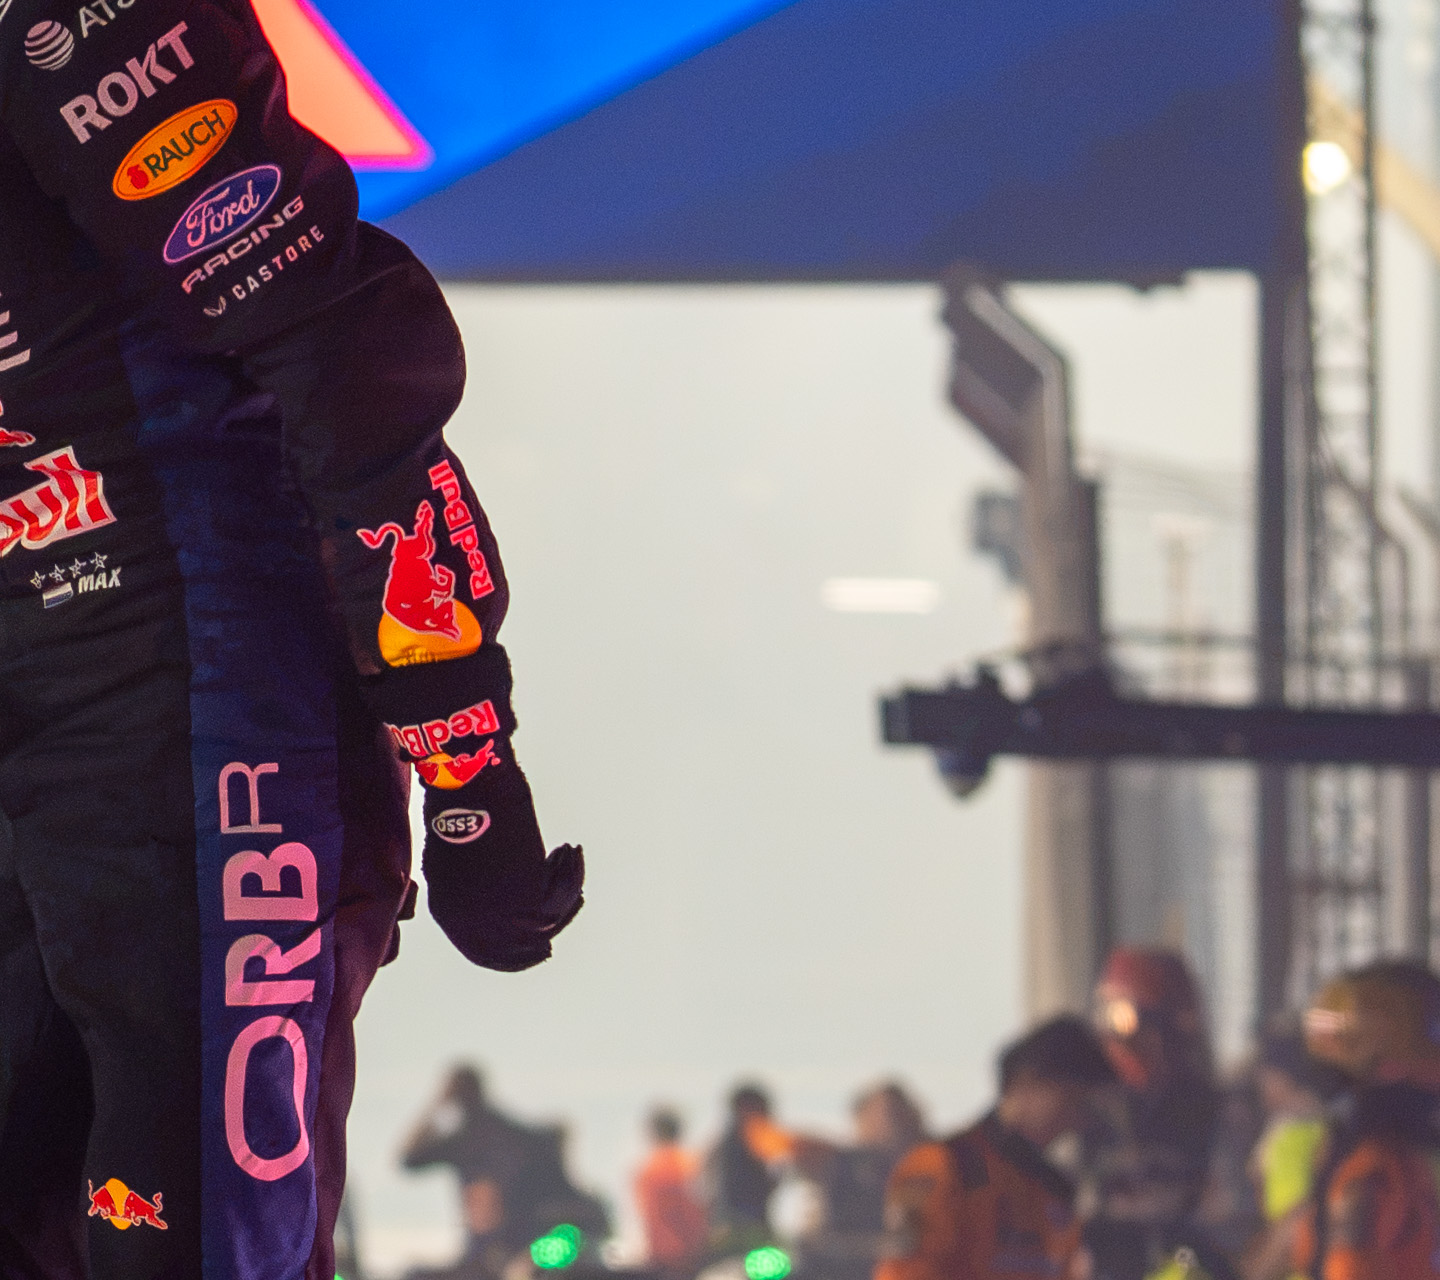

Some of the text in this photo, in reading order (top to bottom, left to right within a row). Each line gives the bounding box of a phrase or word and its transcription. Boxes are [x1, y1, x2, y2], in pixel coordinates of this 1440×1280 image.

[60, 21, 195, 144] ROKT
[143, 108, 227, 179] RAUCH
[180, 195, 305, 295] RACING
[185, 179, 261, 248] Ford
[232, 224, 325, 301] CASTORE
[78, 568, 122, 594] MAX
[218, 761, 321, 1182] ORBR
